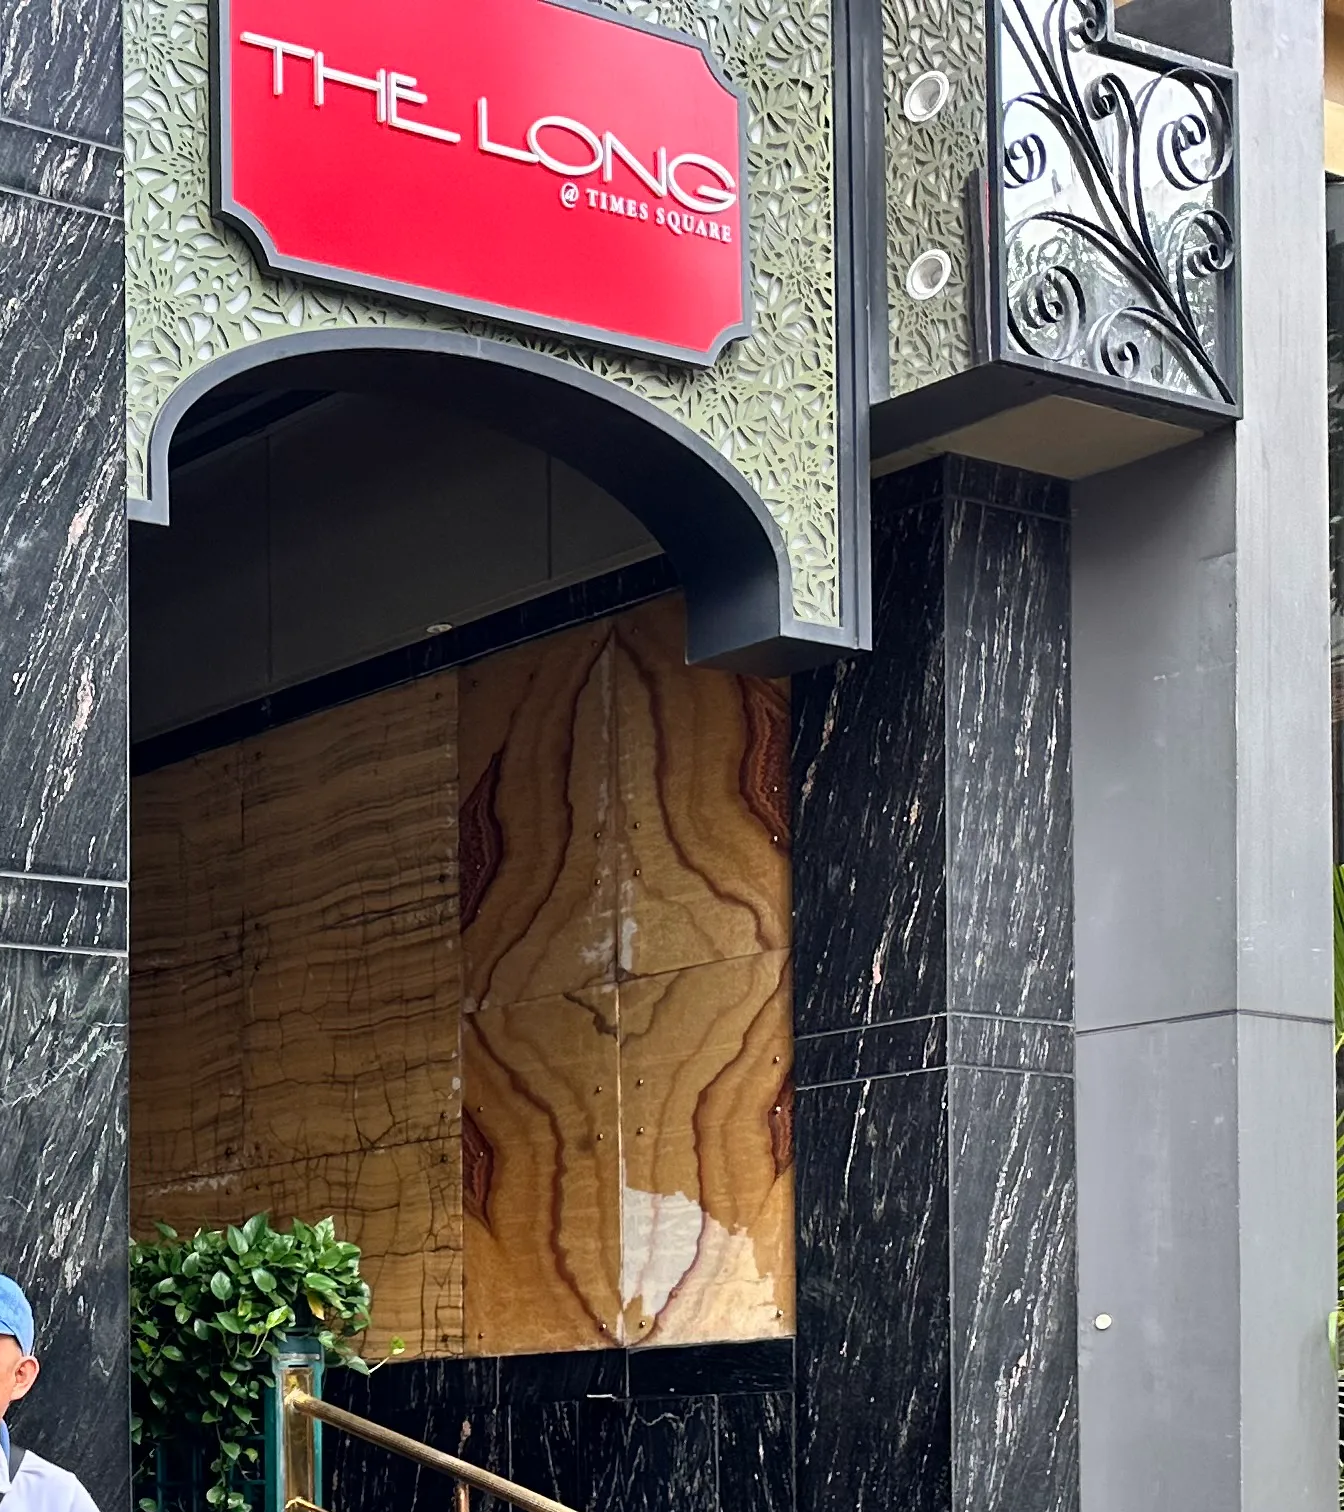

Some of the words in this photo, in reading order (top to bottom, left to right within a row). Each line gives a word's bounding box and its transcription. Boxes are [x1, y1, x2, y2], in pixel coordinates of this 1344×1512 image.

[240, 31, 461, 144] THE
[478, 96, 738, 214] LONG
[559, 182, 579, 208] @
[585, 188, 648, 221] TIMES
[655, 207, 732, 243] SQUARE
